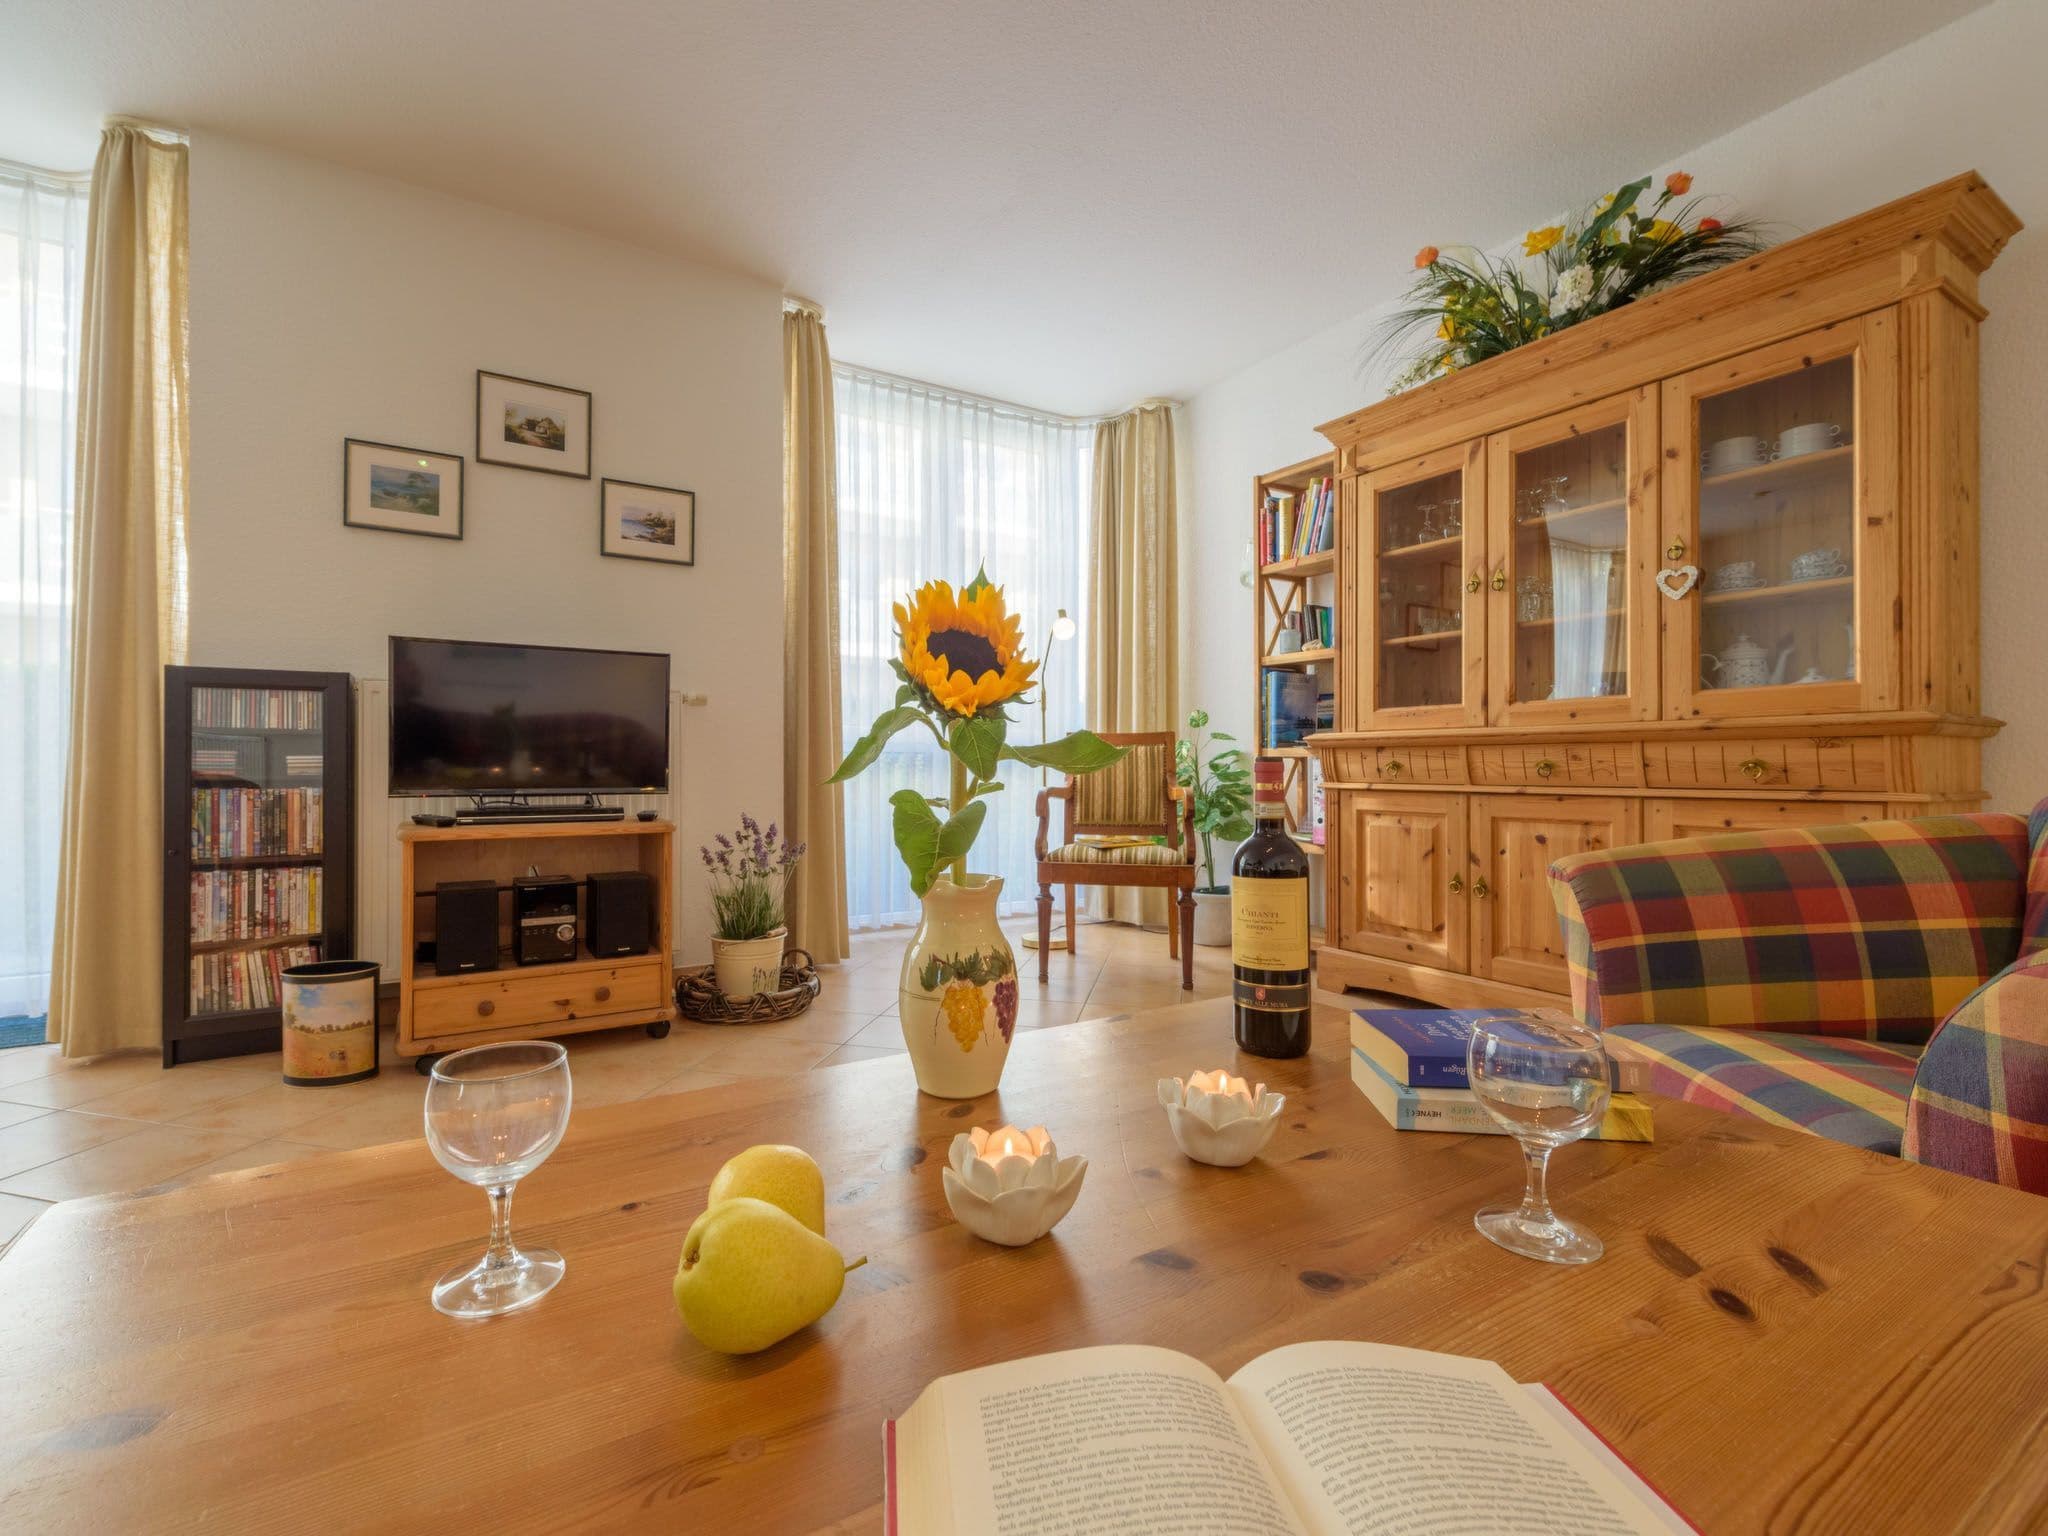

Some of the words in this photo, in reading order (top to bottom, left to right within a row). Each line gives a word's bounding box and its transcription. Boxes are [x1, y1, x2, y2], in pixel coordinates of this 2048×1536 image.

[1241, 905, 1280, 918] CHIANTI
[1442, 1064, 1466, 1075] Rügen
[1415, 1109, 1442, 1118] HEYNE
